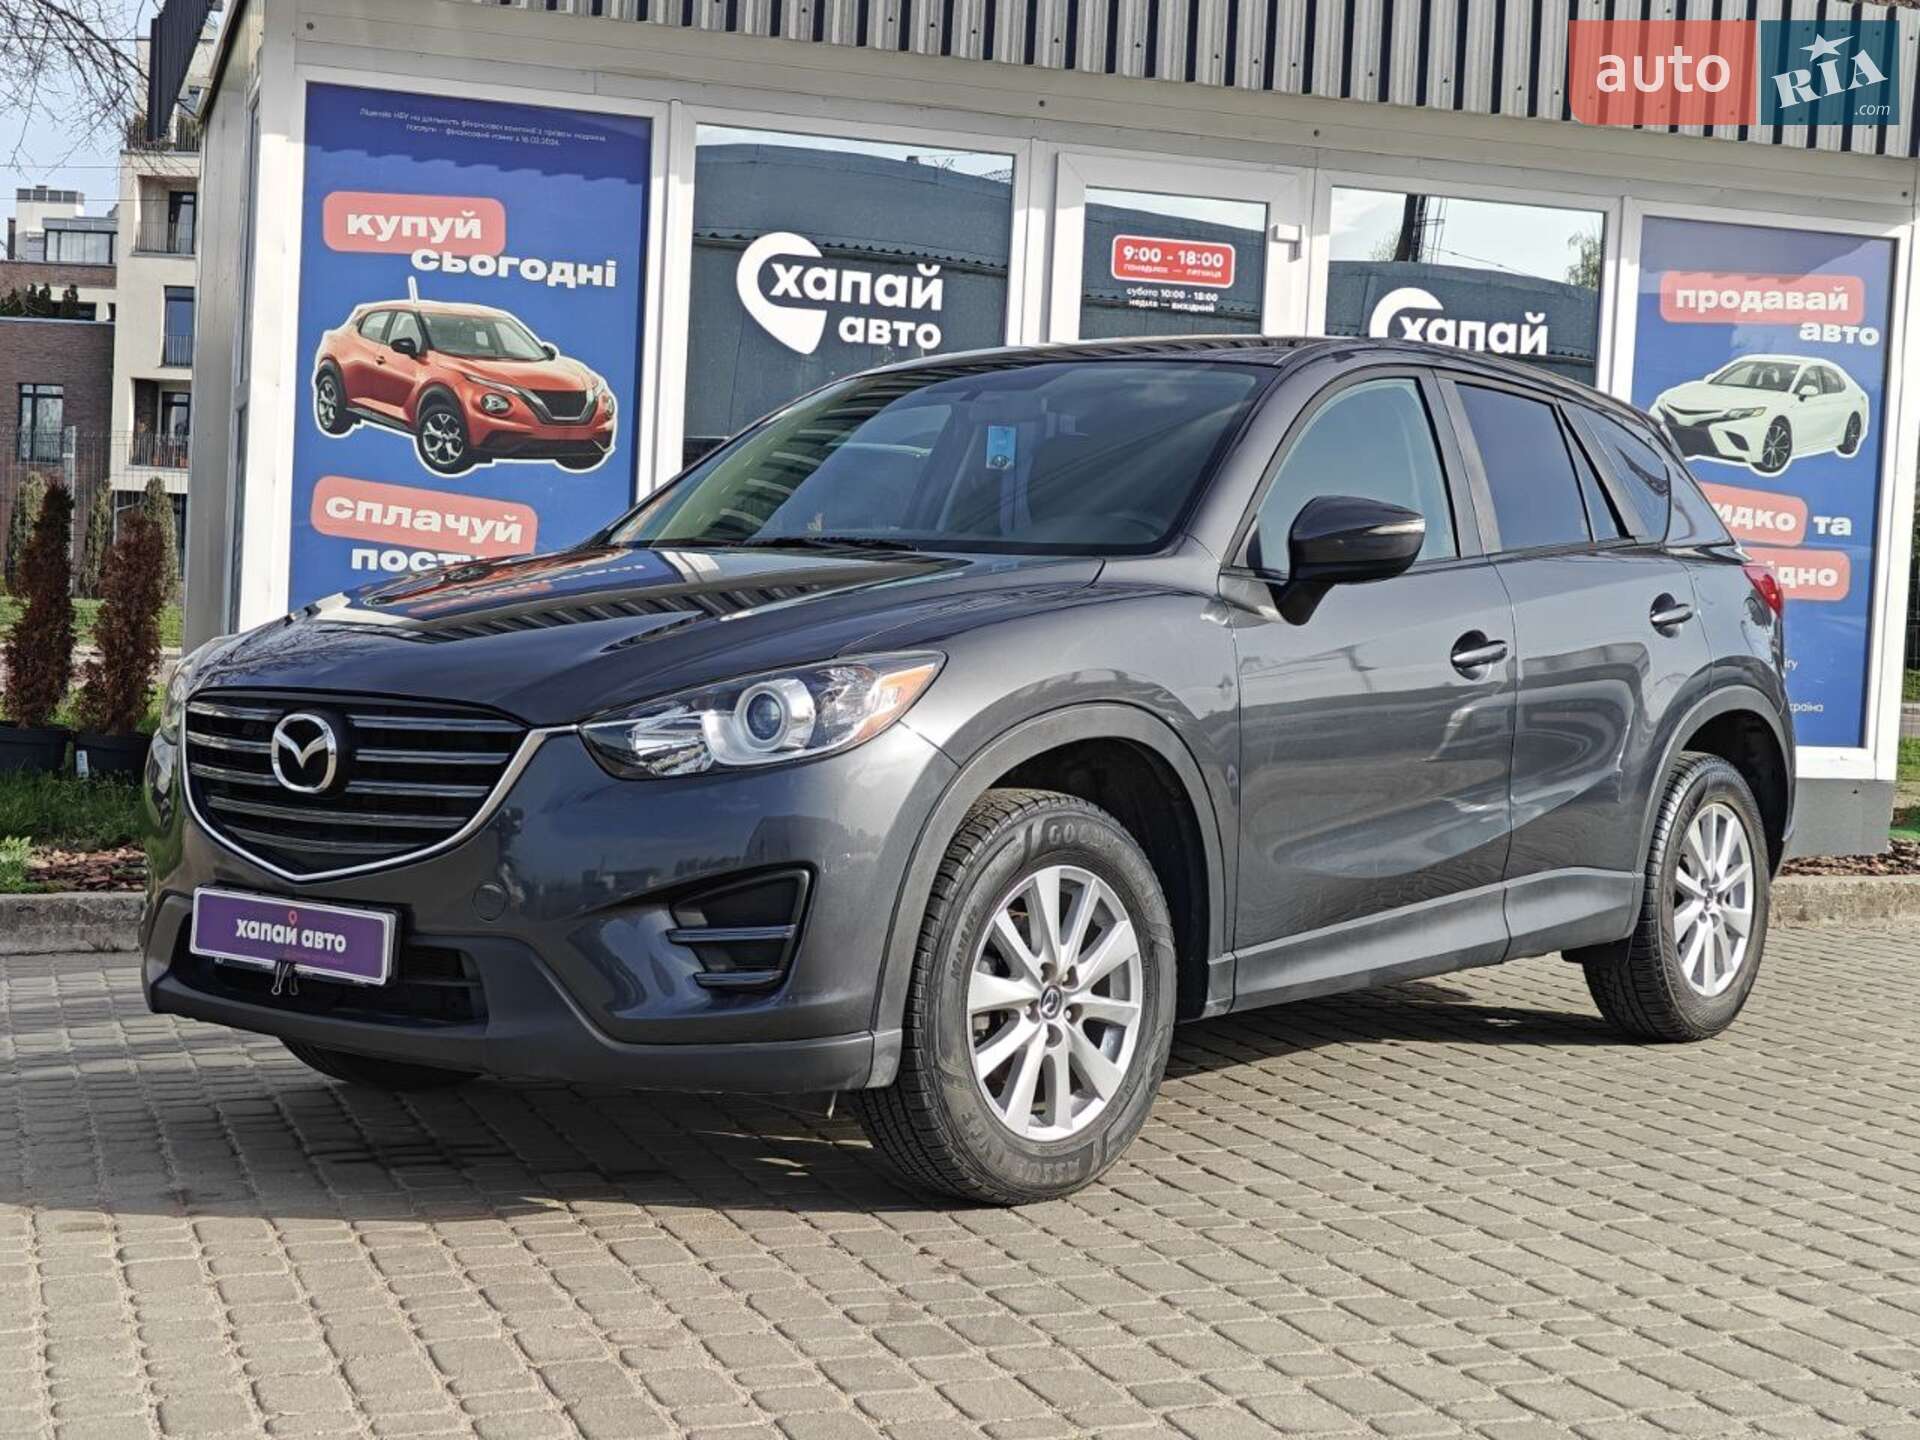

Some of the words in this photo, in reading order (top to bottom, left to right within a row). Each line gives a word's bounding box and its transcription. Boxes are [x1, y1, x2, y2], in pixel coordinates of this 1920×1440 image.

[347, 210, 481, 244] купуй
[411, 249, 617, 289] сьогодні
[1123, 245, 1162, 262] 9:00
[1178, 249, 1224, 268] 18:00
[769, 263, 944, 311] хапай
[1675, 286, 1849, 313] продавай
[838, 316, 942, 349] авто
[1400, 311, 1548, 356] хапай
[1799, 322, 1880, 346] авто
[324, 496, 522, 545] сплачуй
[1813, 516, 1852, 536] та
[301, 928, 347, 953] авто
